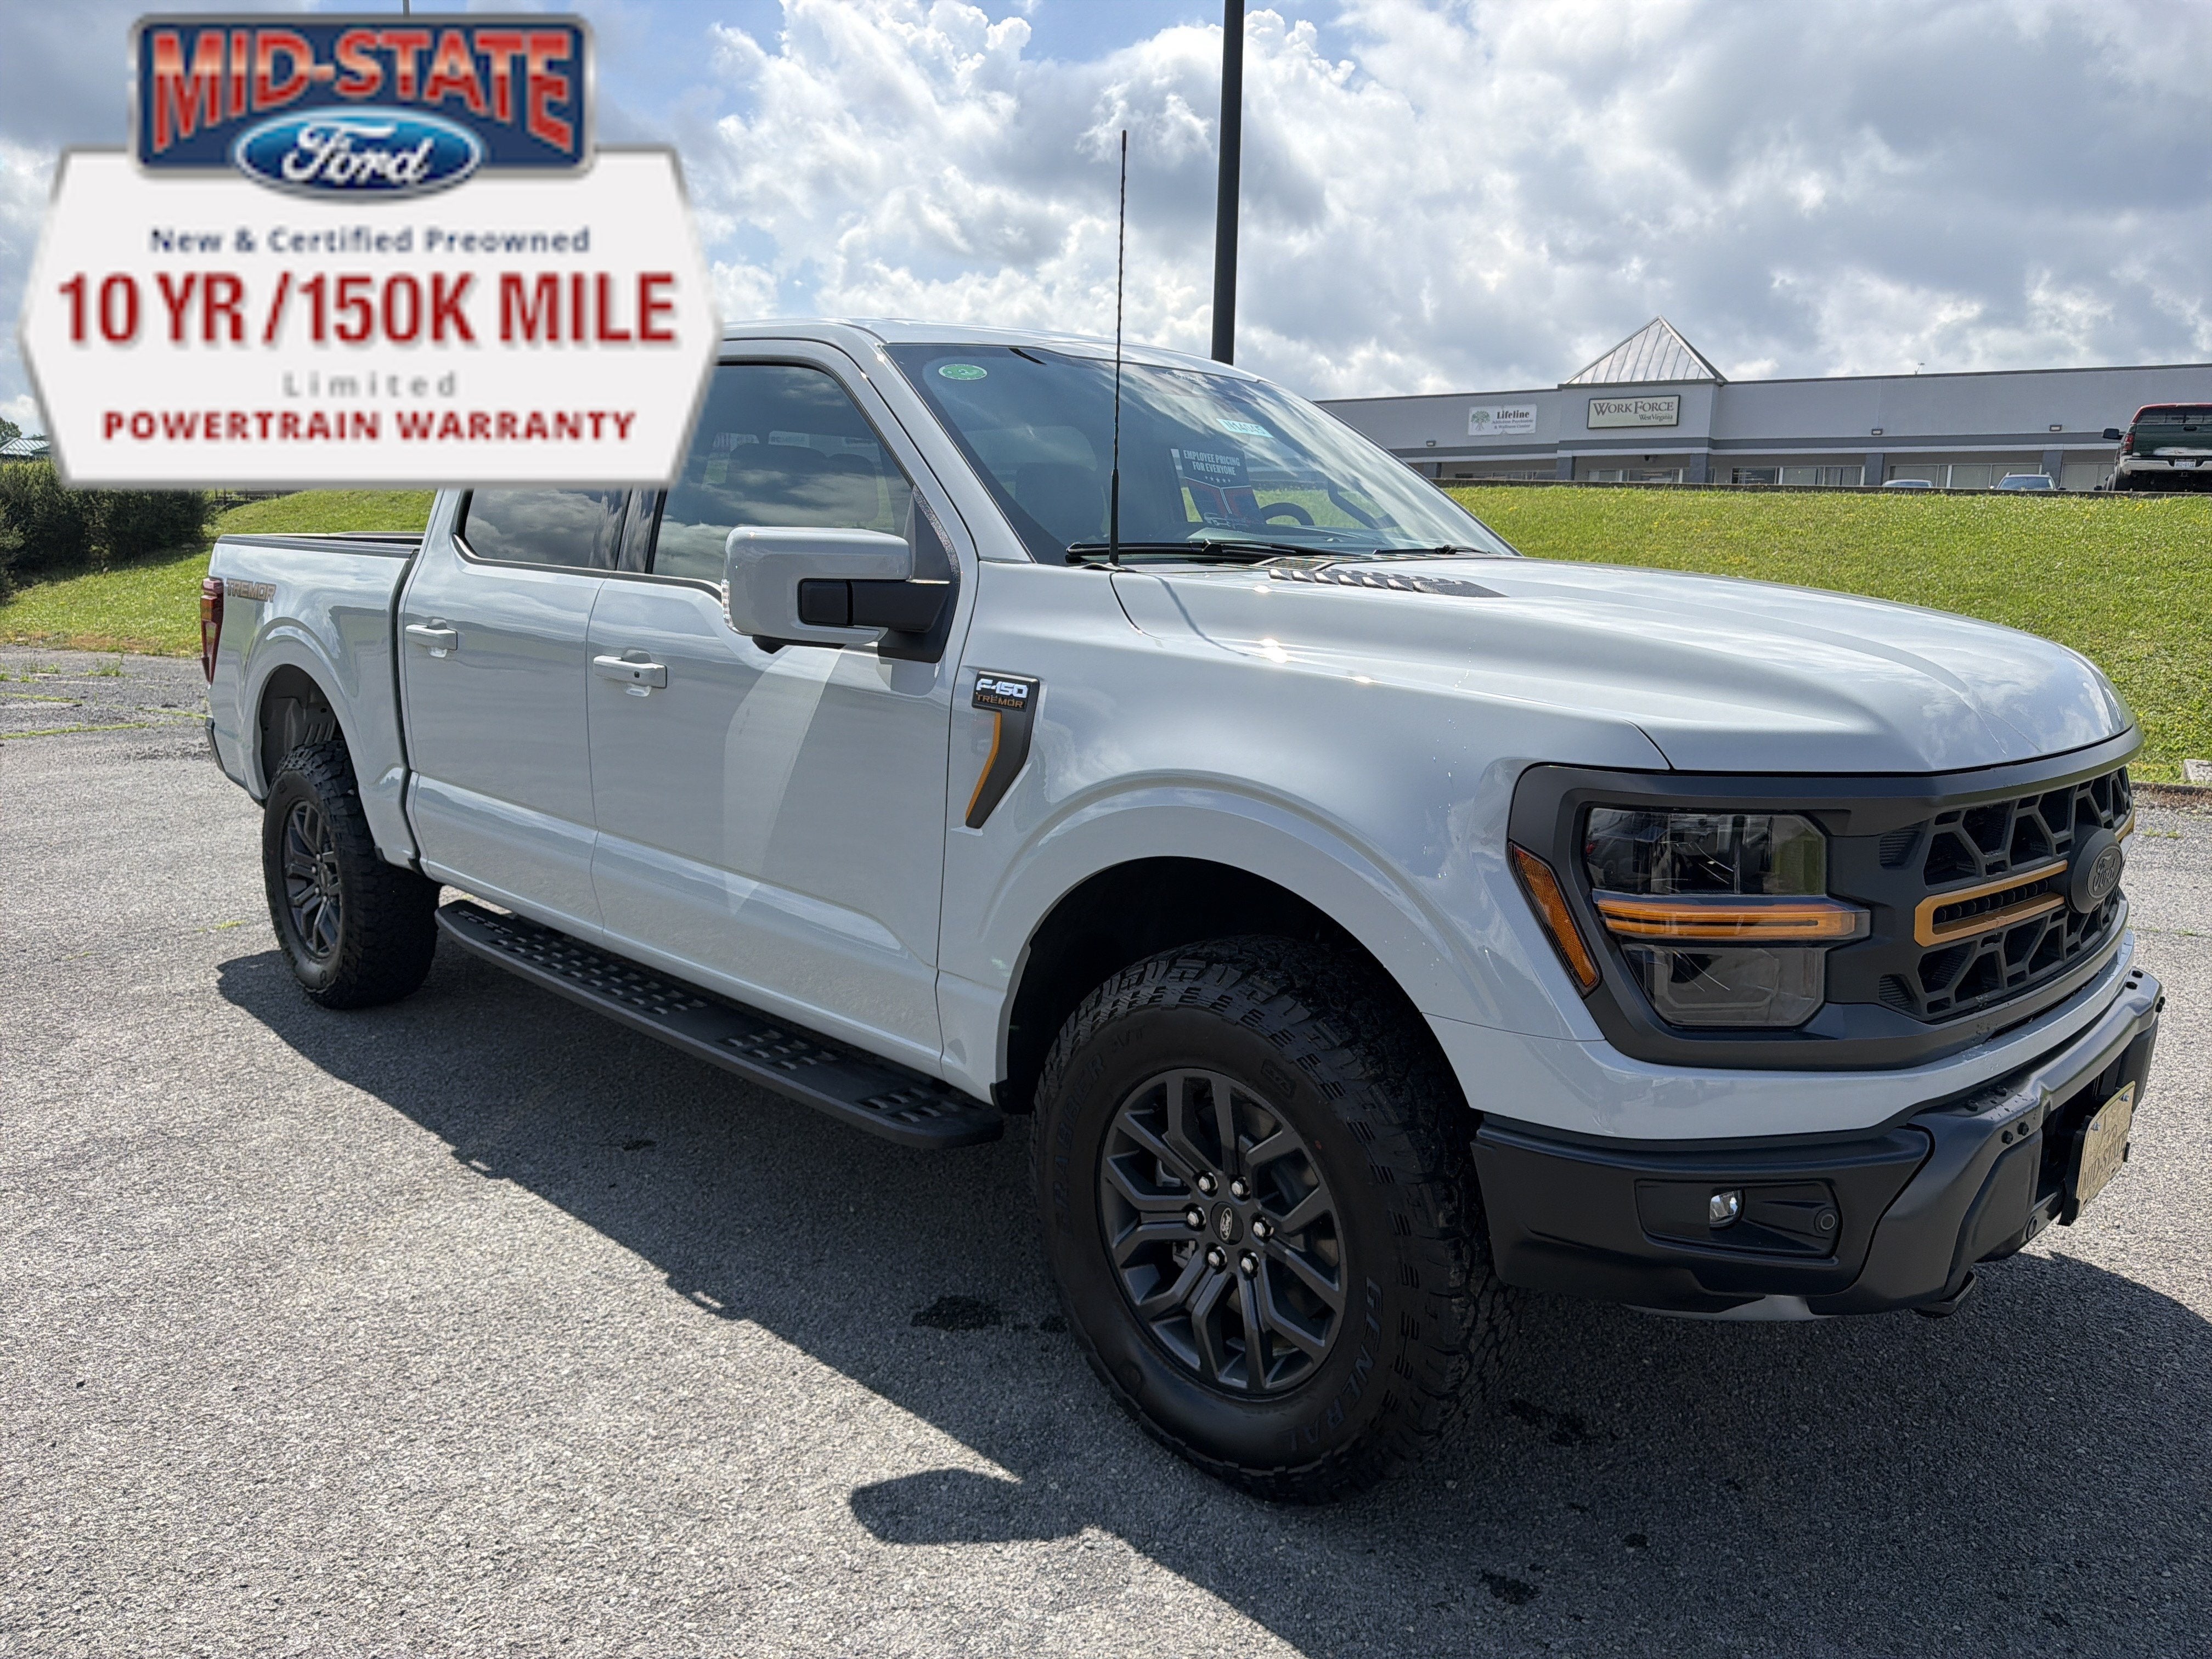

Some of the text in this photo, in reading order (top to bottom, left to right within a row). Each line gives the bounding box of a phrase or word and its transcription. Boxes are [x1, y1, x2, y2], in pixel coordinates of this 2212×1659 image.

[1497, 410, 1530, 419] Lifeline
[1651, 413, 1673, 422] Virginia
[1183, 450, 1240, 466] EMPLOYEE PRICING
[1192, 461, 1236, 476] FOR EVERYONE
[227, 578, 276, 603] TREMOR
[976, 678, 1028, 698] F-150
[977, 694, 1024, 708] TREMOR
